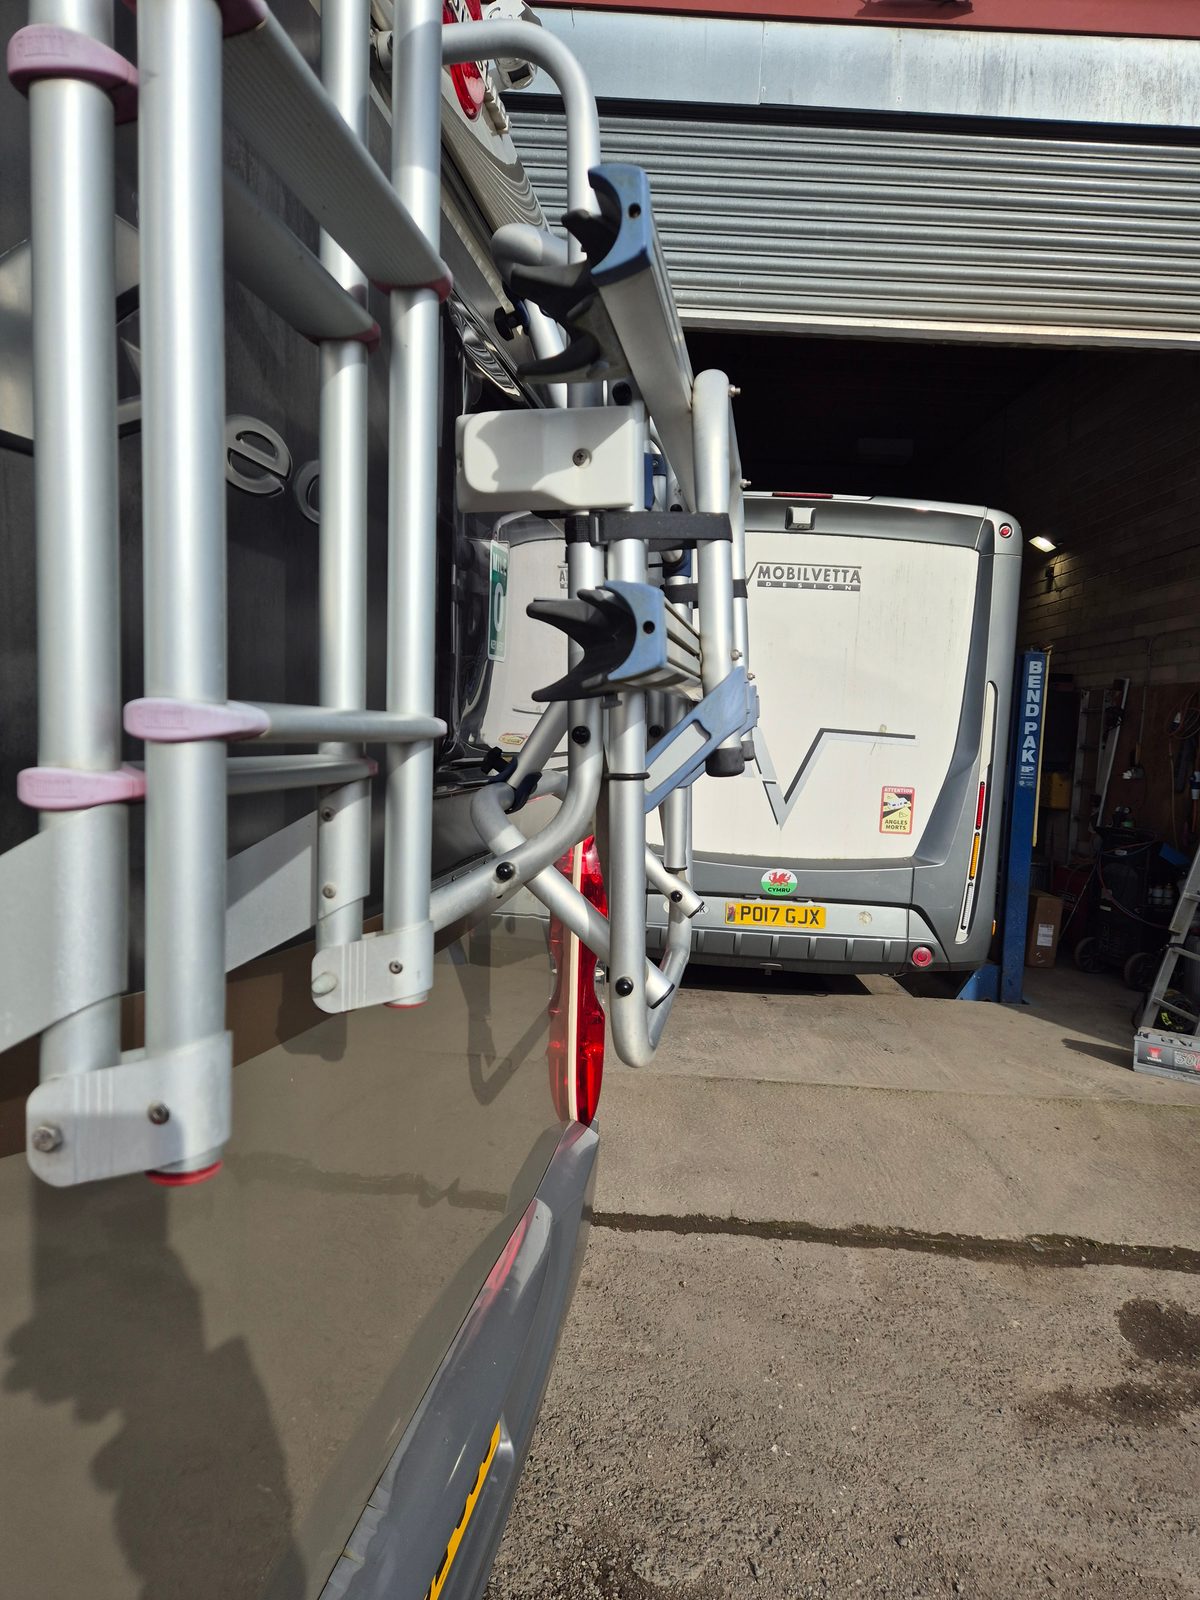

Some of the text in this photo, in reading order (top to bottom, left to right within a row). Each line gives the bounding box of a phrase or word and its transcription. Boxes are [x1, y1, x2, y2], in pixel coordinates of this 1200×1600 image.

[757, 565, 861, 584] MOBILVETTA
[765, 581, 852, 591] DESIGN
[740, 905, 820, 925] PO17 GJX
